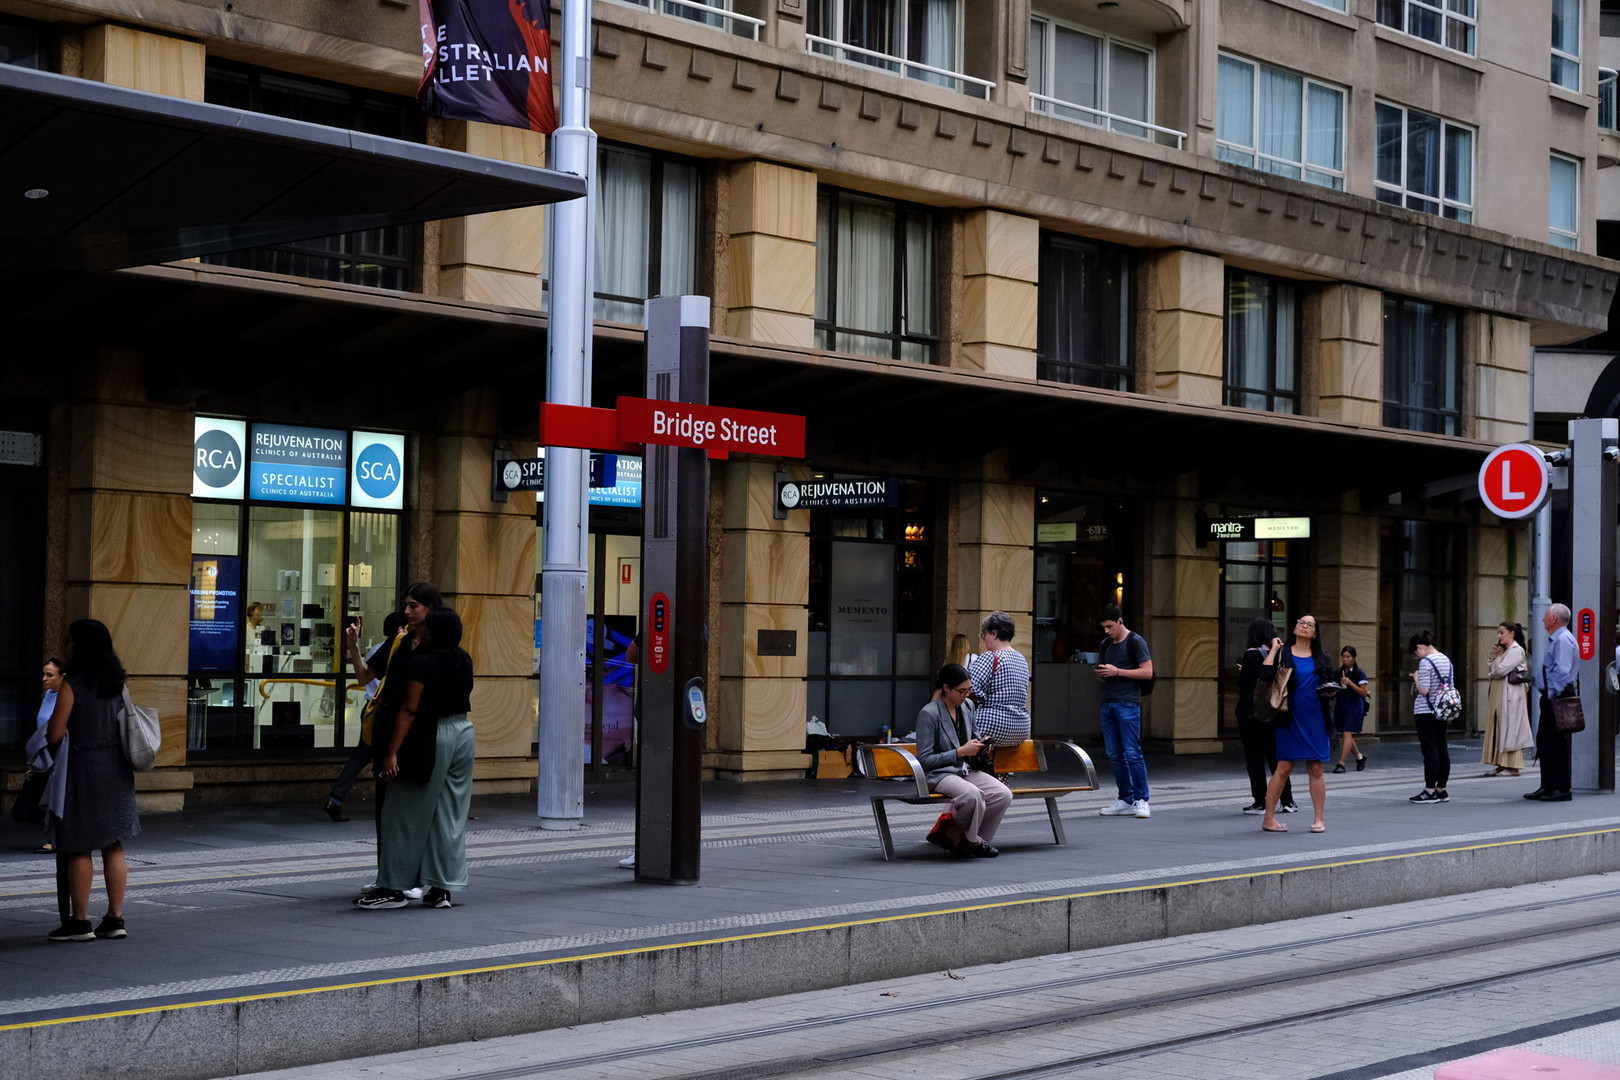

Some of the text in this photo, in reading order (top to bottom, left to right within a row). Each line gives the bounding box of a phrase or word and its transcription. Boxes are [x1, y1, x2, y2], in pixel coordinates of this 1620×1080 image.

[421, 24, 447, 42] TE
[422, 43, 548, 75] ASTRALIAN
[653, 410, 777, 446] Bridge Street
[255, 433, 343, 451] REJUVENATION
[196, 448, 237, 470] RCA
[255, 448, 286, 457] CLINICS
[301, 451, 342, 461] AUSTRALIA
[360, 461, 396, 481] SCA
[505, 470, 519, 480] SCA
[262, 472, 335, 489] SPECIALIST
[521, 478, 543, 487] CLINIC
[1502, 460, 1525, 500] L
[261, 487, 287, 495] CLINICS
[300, 490, 334, 498] AUSTRALIA
[782, 490, 798, 500] RCA
[800, 481, 886, 499] REJUVENATION
[844, 497, 885, 505] AUSTRALIA
[837, 606, 888, 615] MEMENTO
